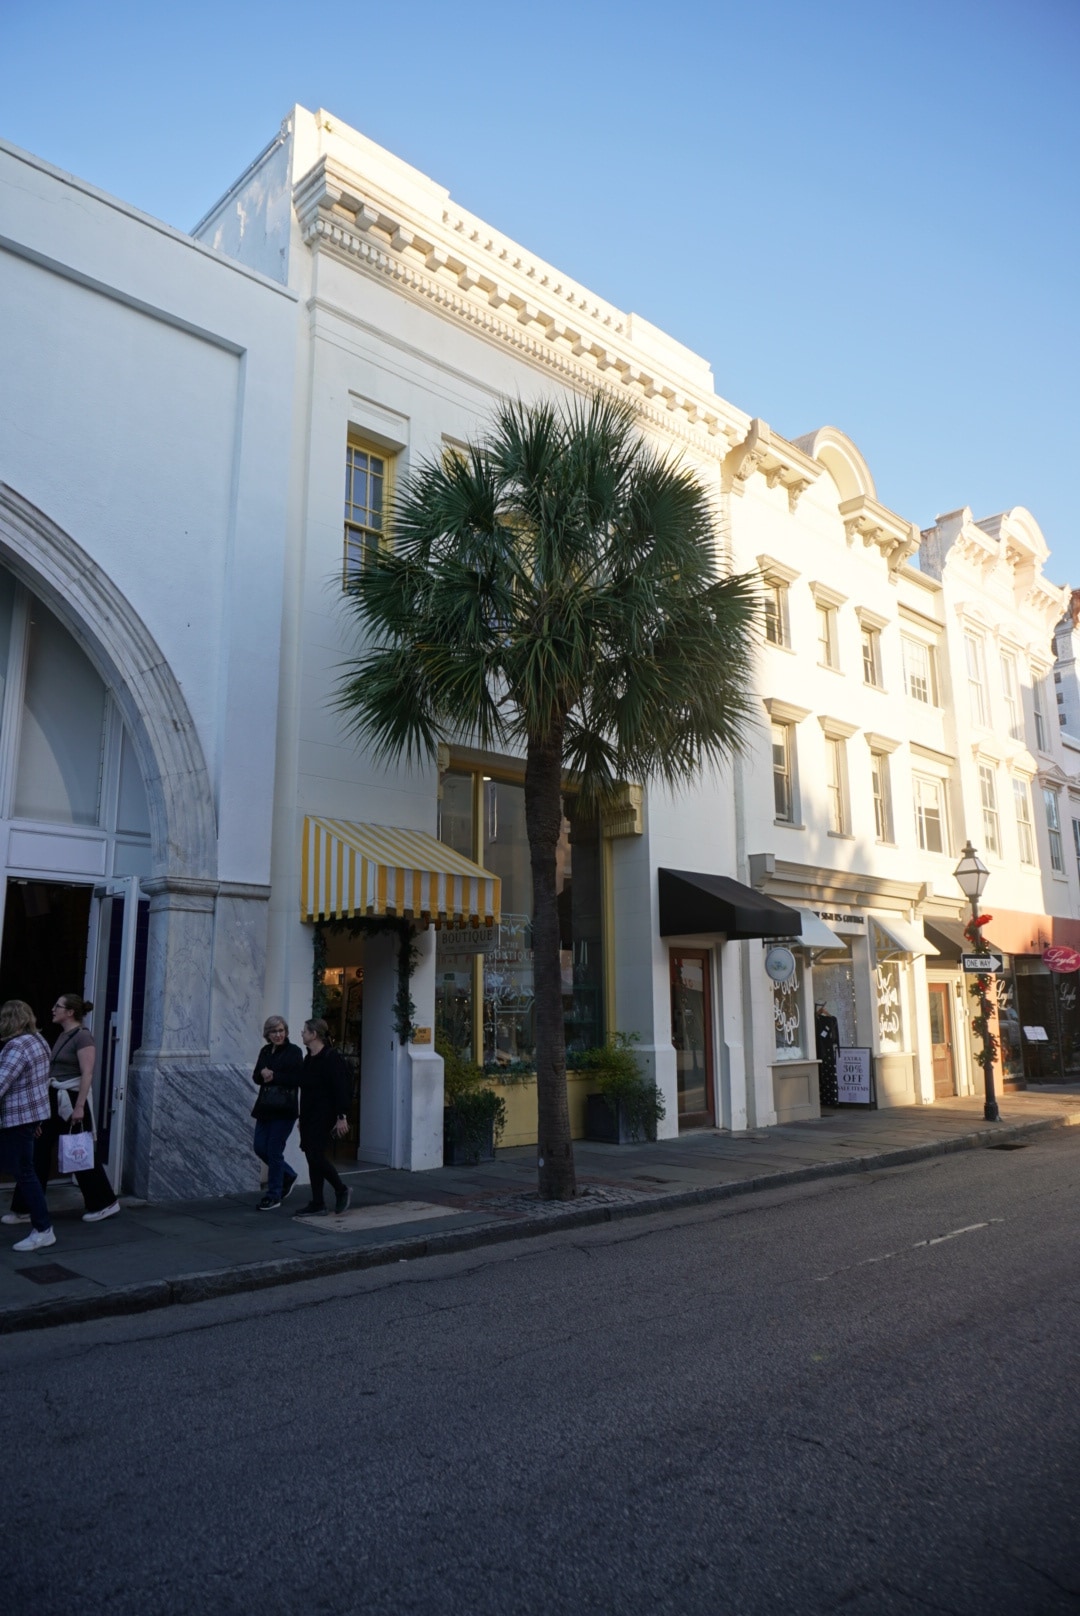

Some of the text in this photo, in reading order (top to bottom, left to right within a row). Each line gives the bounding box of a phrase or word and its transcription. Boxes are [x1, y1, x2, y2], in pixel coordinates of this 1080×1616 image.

[442, 930, 493, 944] BOUTIQUE
[843, 1064, 863, 1073] 30%
[843, 1074, 864, 1083] OFF
